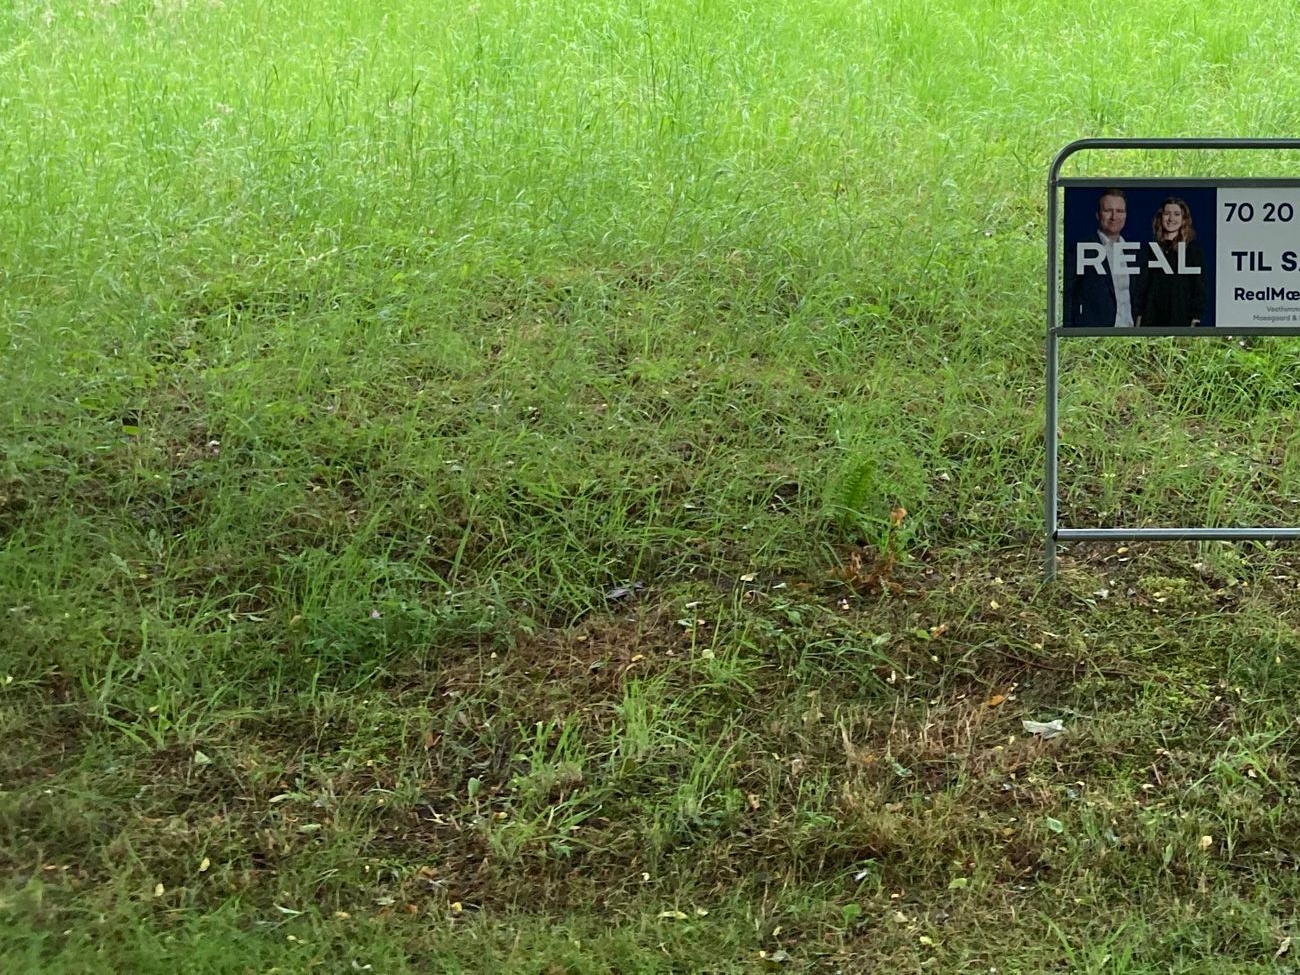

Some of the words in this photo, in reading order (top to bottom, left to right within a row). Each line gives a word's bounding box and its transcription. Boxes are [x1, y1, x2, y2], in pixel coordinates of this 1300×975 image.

[1224, 202, 1254, 222] 70
[1263, 202, 1294, 222] 20
[1076, 241, 1202, 275] REAL
[1231, 251, 1272, 271] TIL
